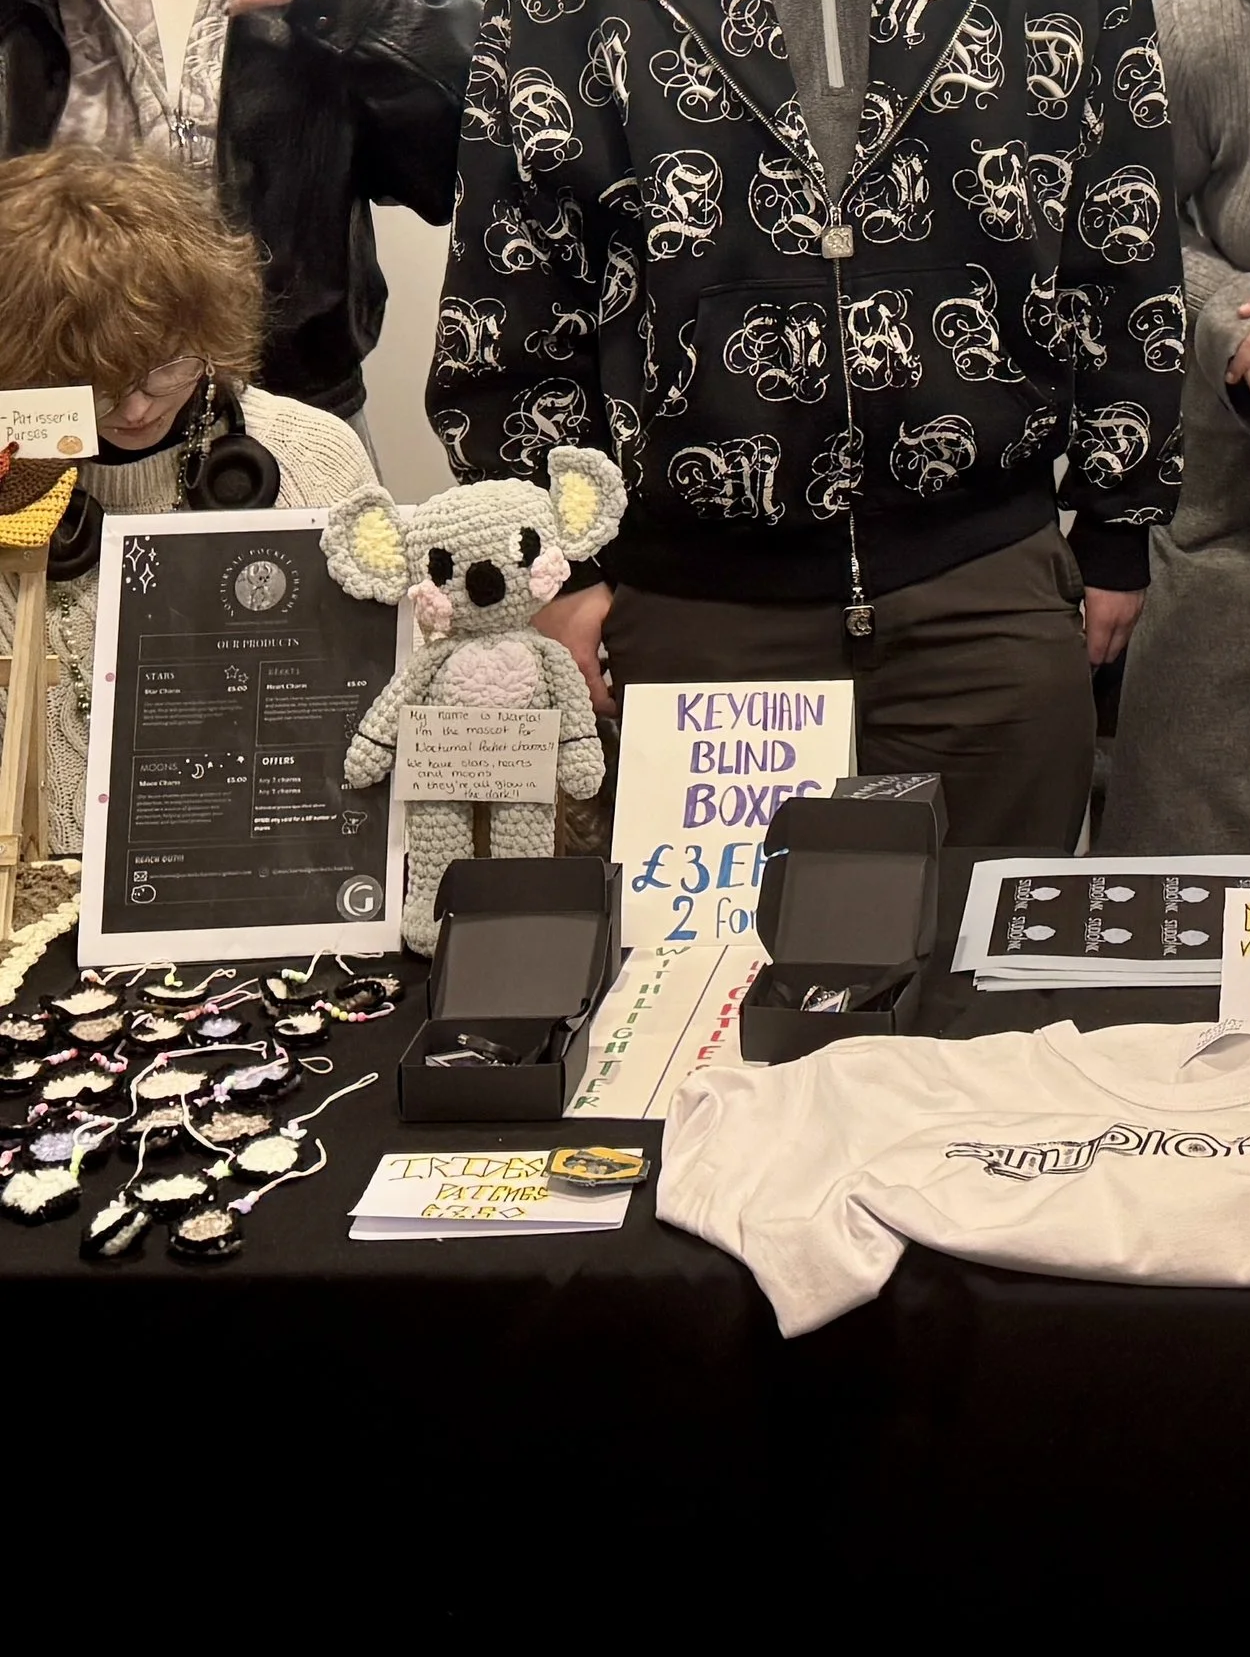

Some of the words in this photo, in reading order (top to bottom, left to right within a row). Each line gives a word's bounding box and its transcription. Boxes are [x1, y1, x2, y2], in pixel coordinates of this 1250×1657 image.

[13, 410, 78, 425] Patisserie
[6, 426, 48, 442] Purses
[410, 710, 428, 727] My
[438, 711, 469, 720] name
[677, 692, 825, 732] KEYCHAIN
[442, 726, 459, 736] the
[466, 726, 510, 735] mascot
[415, 741, 472, 753] Nocturnal
[261, 756, 295, 766] OFFERS
[690, 740, 797, 774] BLIND
[418, 770, 443, 778] and
[451, 770, 492, 778] moons
[664, 895, 698, 941] 2
[389, 1156, 551, 1181] IRIDES
